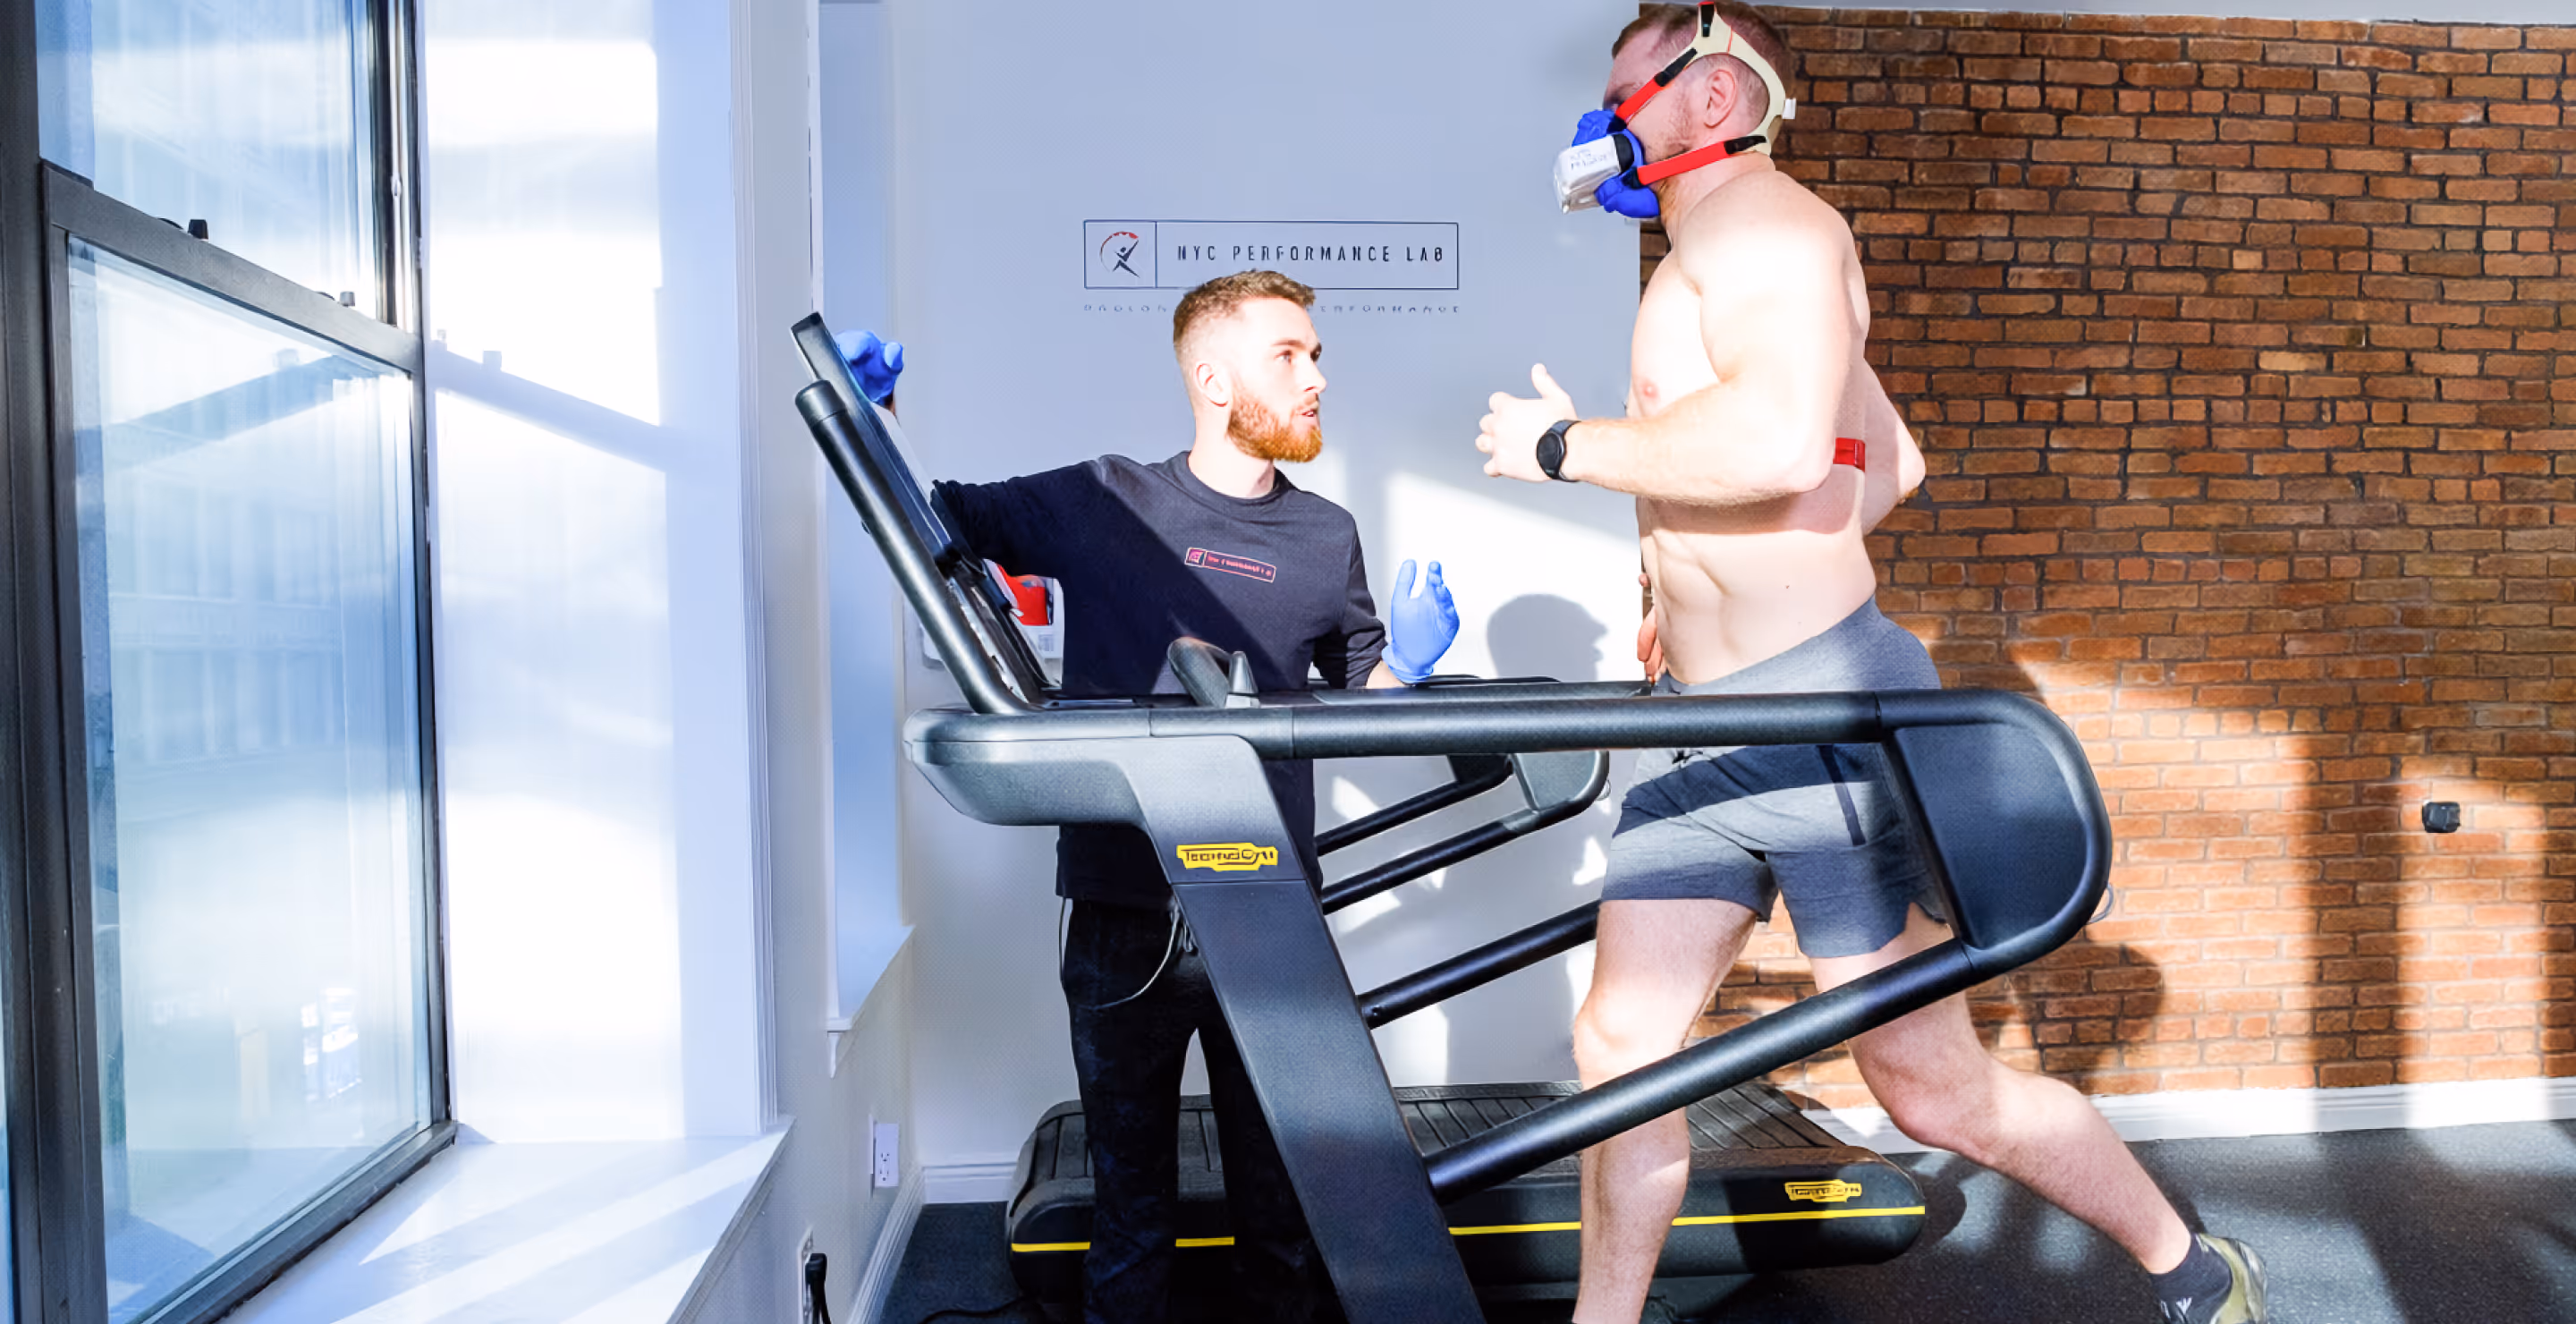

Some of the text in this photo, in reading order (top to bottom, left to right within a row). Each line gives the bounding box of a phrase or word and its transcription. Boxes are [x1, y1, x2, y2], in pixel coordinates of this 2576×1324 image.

[1177, 245, 1443, 262] NYC PERFORMANCE LAB
